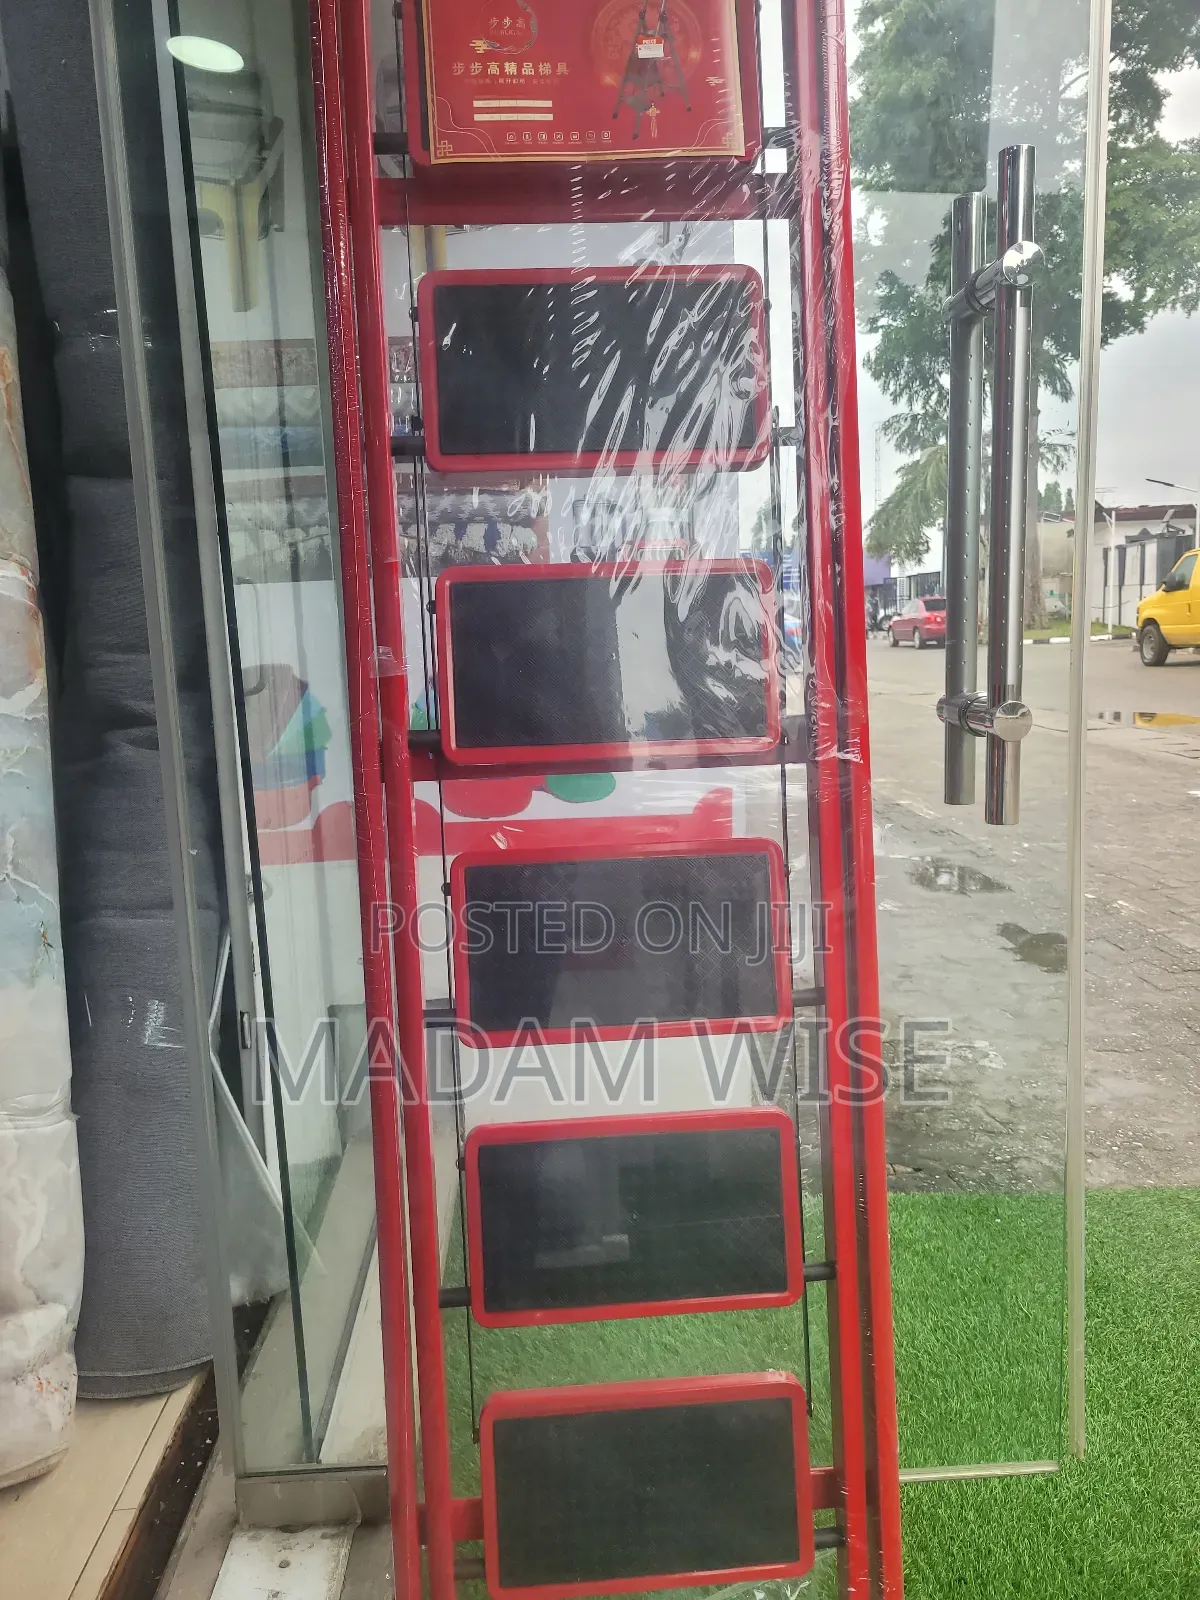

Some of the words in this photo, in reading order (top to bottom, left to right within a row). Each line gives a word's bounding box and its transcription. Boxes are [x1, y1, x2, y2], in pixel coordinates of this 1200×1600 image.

[452, 61, 569, 76] 步步高精品梯具
